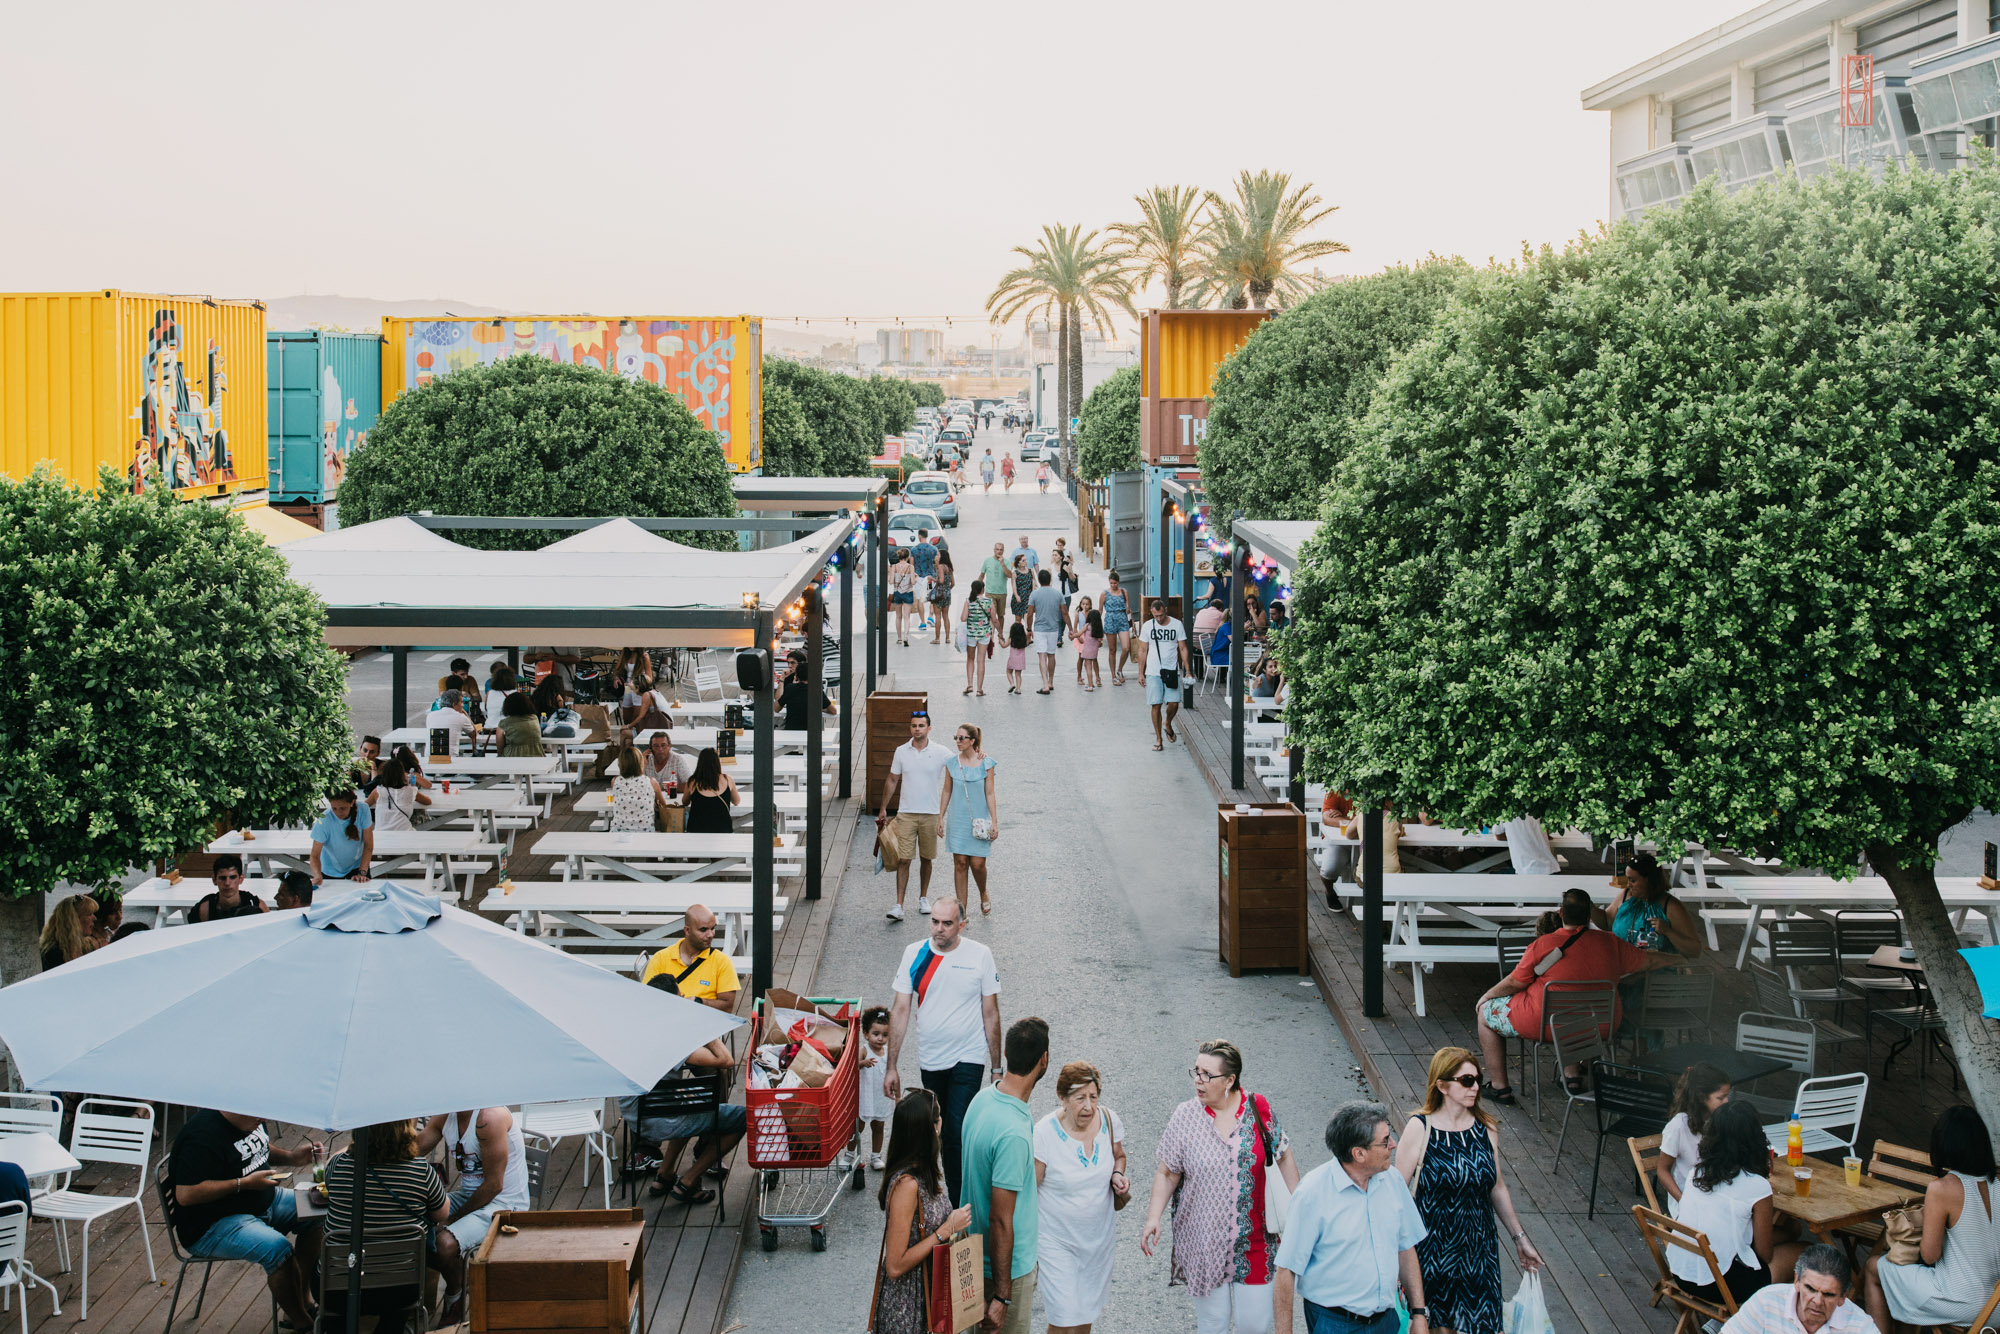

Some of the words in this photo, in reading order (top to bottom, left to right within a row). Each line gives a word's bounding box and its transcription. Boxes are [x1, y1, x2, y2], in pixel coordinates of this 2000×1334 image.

[956, 1247, 971, 1264] SHOP
[958, 1260, 972, 1277] SHOP
[960, 1273, 974, 1290] SHOP
[962, 1285, 976, 1302] SALE
